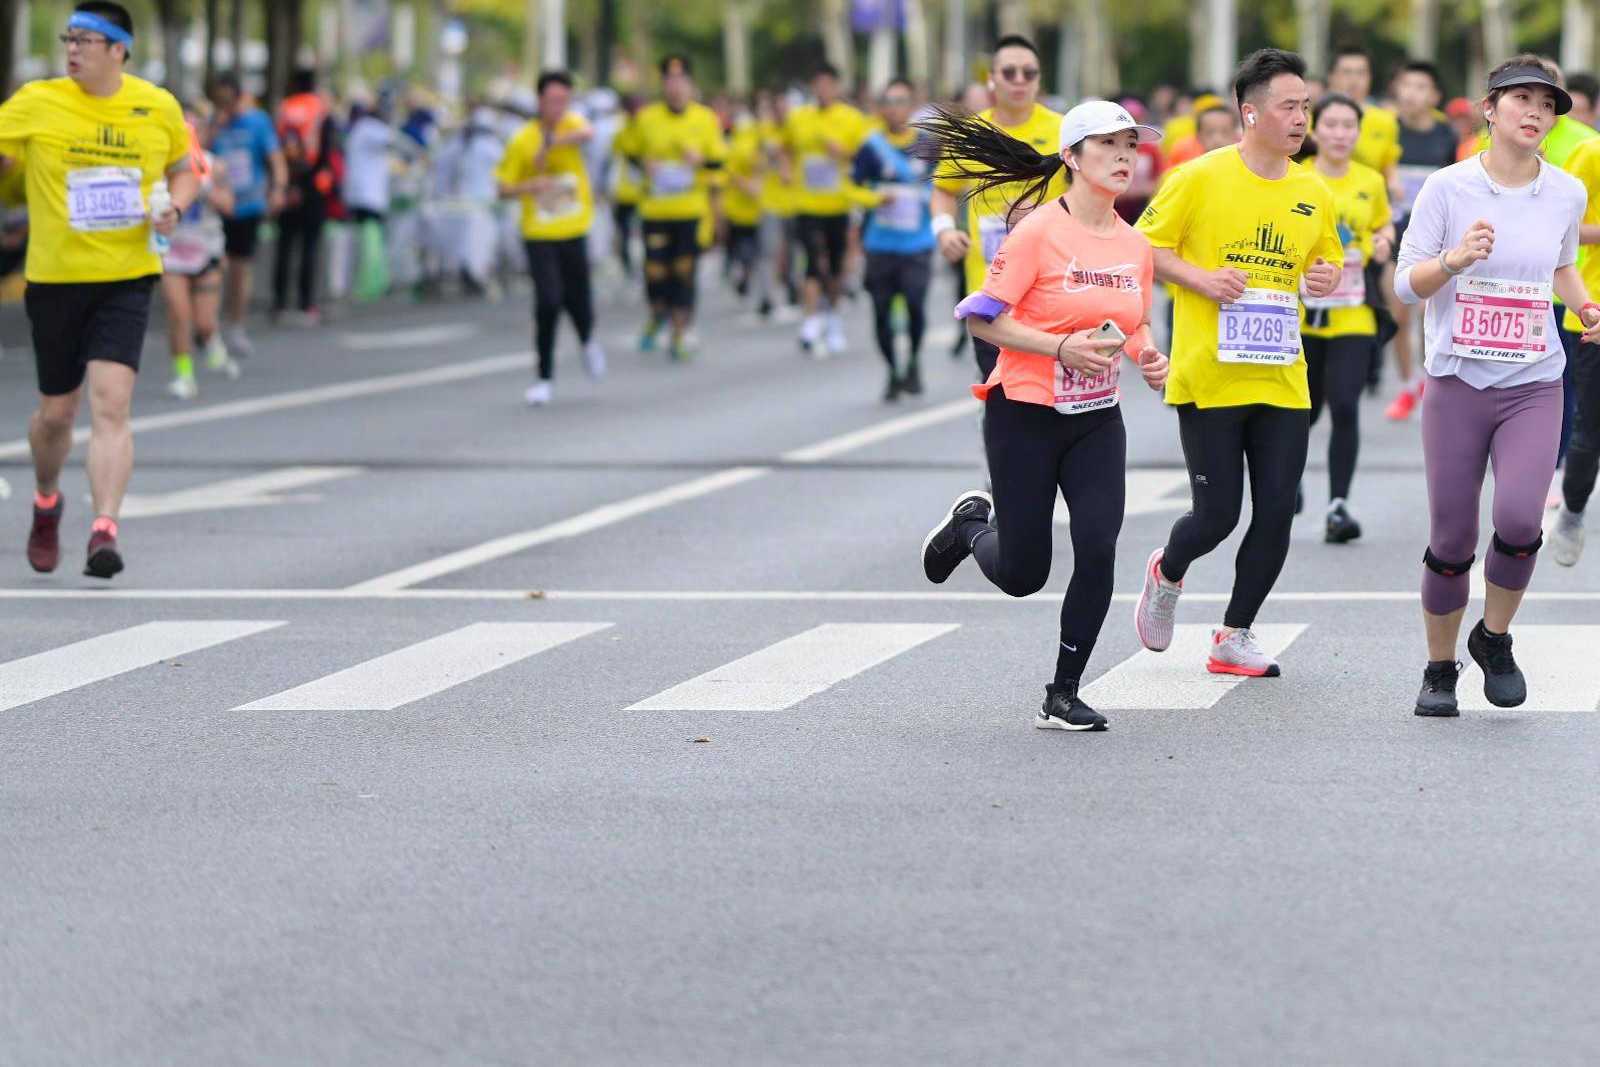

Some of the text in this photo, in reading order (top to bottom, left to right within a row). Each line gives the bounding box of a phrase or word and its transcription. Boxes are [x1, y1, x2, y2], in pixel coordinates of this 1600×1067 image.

[1224, 252, 1297, 271] SKECHERS
[1226, 315, 1284, 344] B4269
[1461, 307, 1525, 339] B5075
[1235, 352, 1286, 362] SKECHERS
[1470, 348, 1527, 359] SKECHERS
[1070, 397, 1115, 410] SKECHERS
